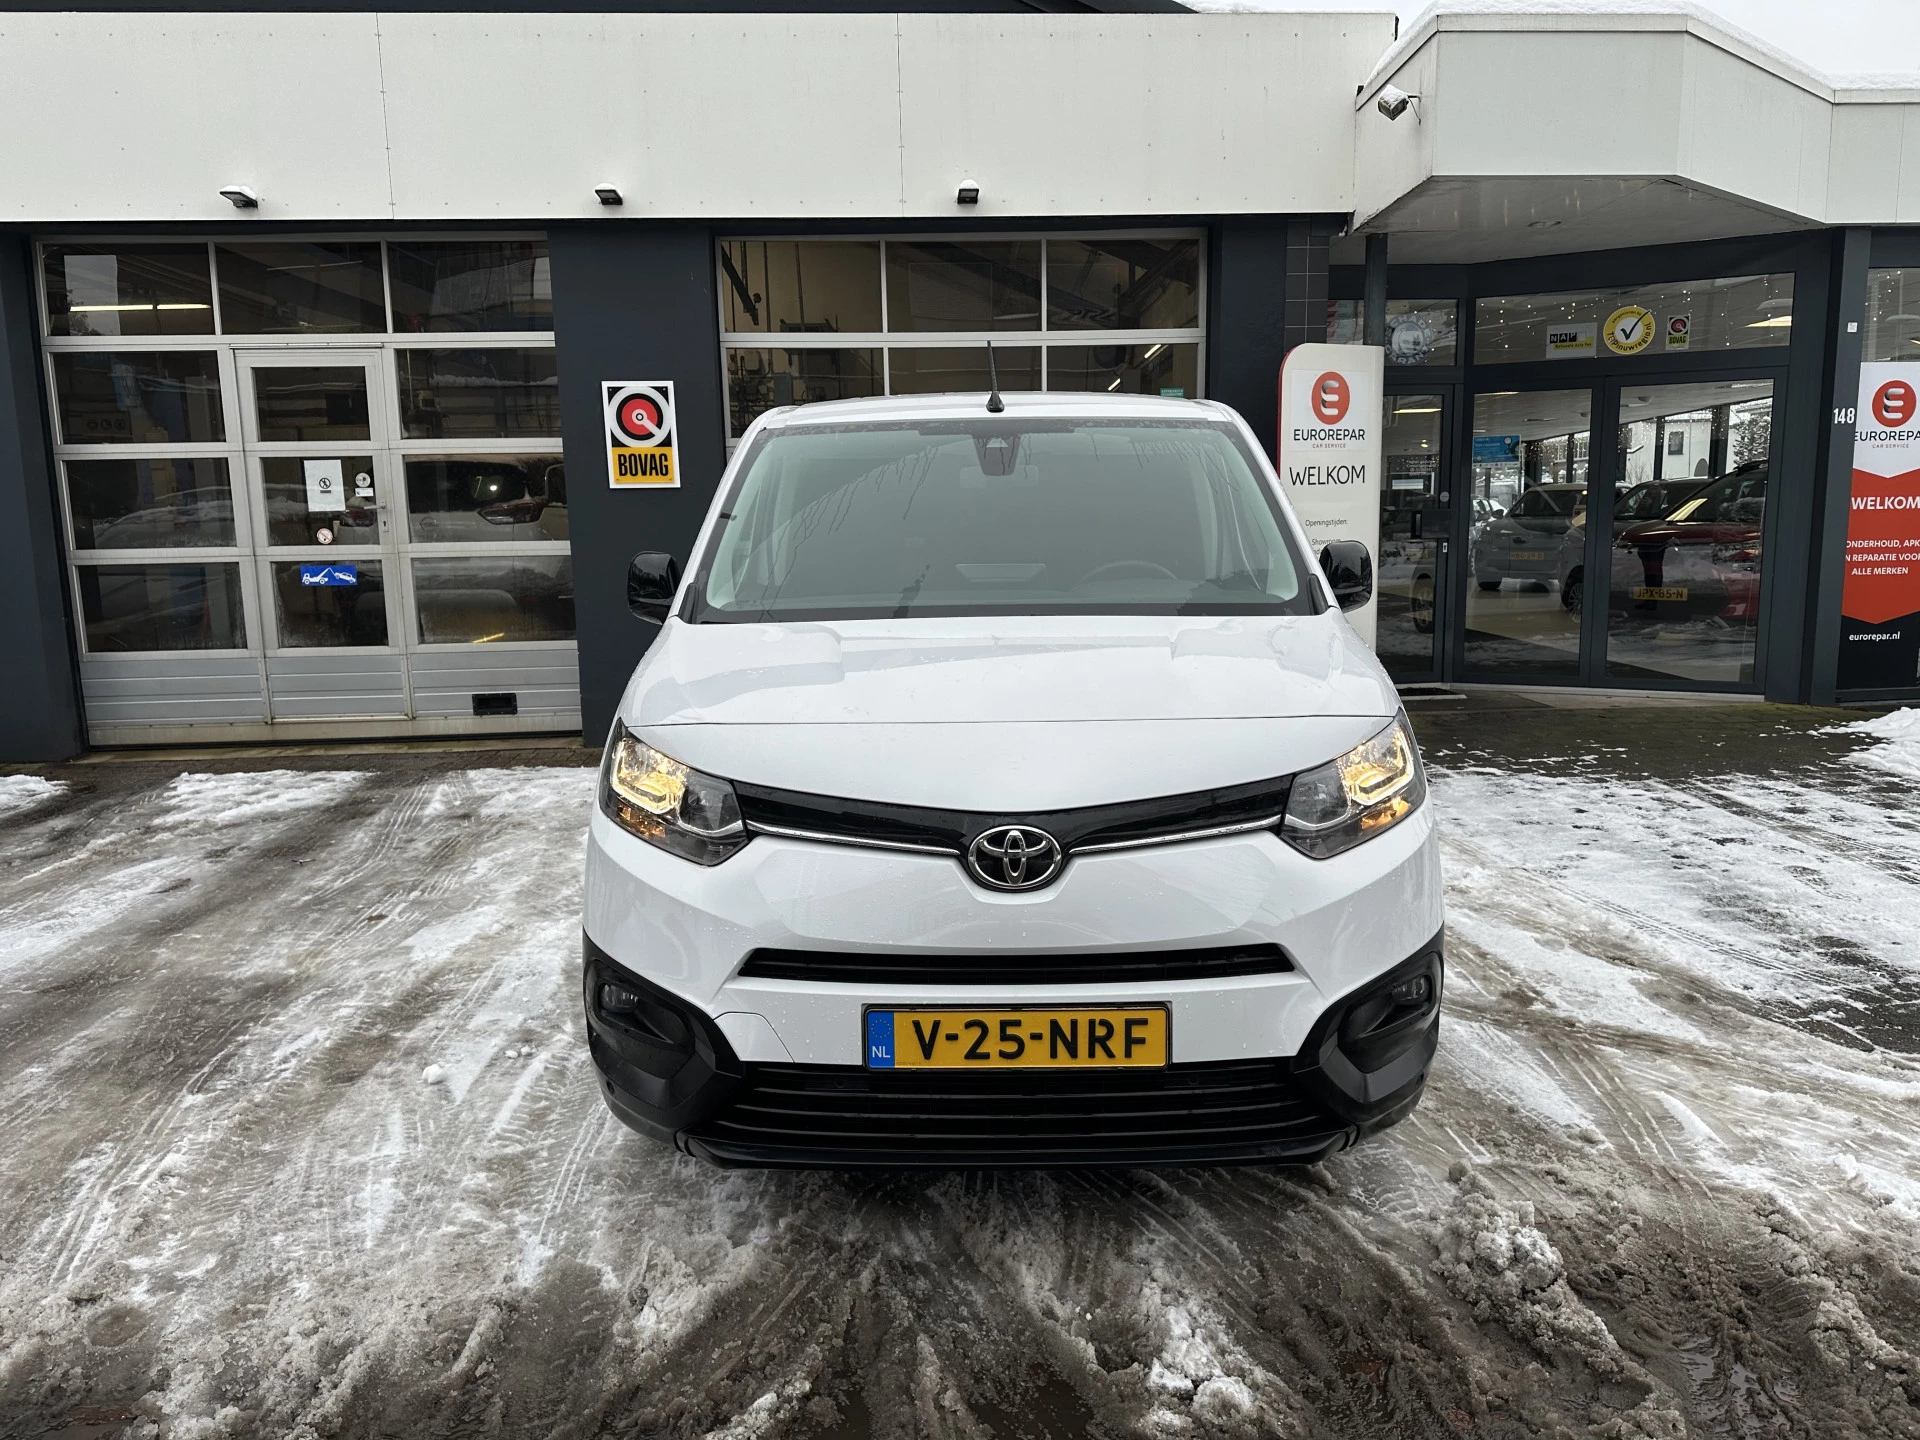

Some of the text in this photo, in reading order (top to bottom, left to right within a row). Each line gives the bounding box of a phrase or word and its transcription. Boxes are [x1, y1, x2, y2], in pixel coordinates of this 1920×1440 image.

[1550, 332, 1577, 343] NAP
[1833, 408, 1855, 424] 148
[1293, 428, 1366, 441] EUROREPAR
[617, 452, 669, 477] BOVAG
[1289, 464, 1366, 486] WELKOM
[1851, 495, 1920, 510] WELKOM
[1846, 540, 1902, 549] ONDERHOUD,
[1852, 553, 1898, 562] REPARATIE
[1851, 566, 1909, 576] ALLE MERKEN
[1848, 630, 1901, 642] eurorepar.nl
[871, 1017, 1149, 1061] NL V-25-NRF
